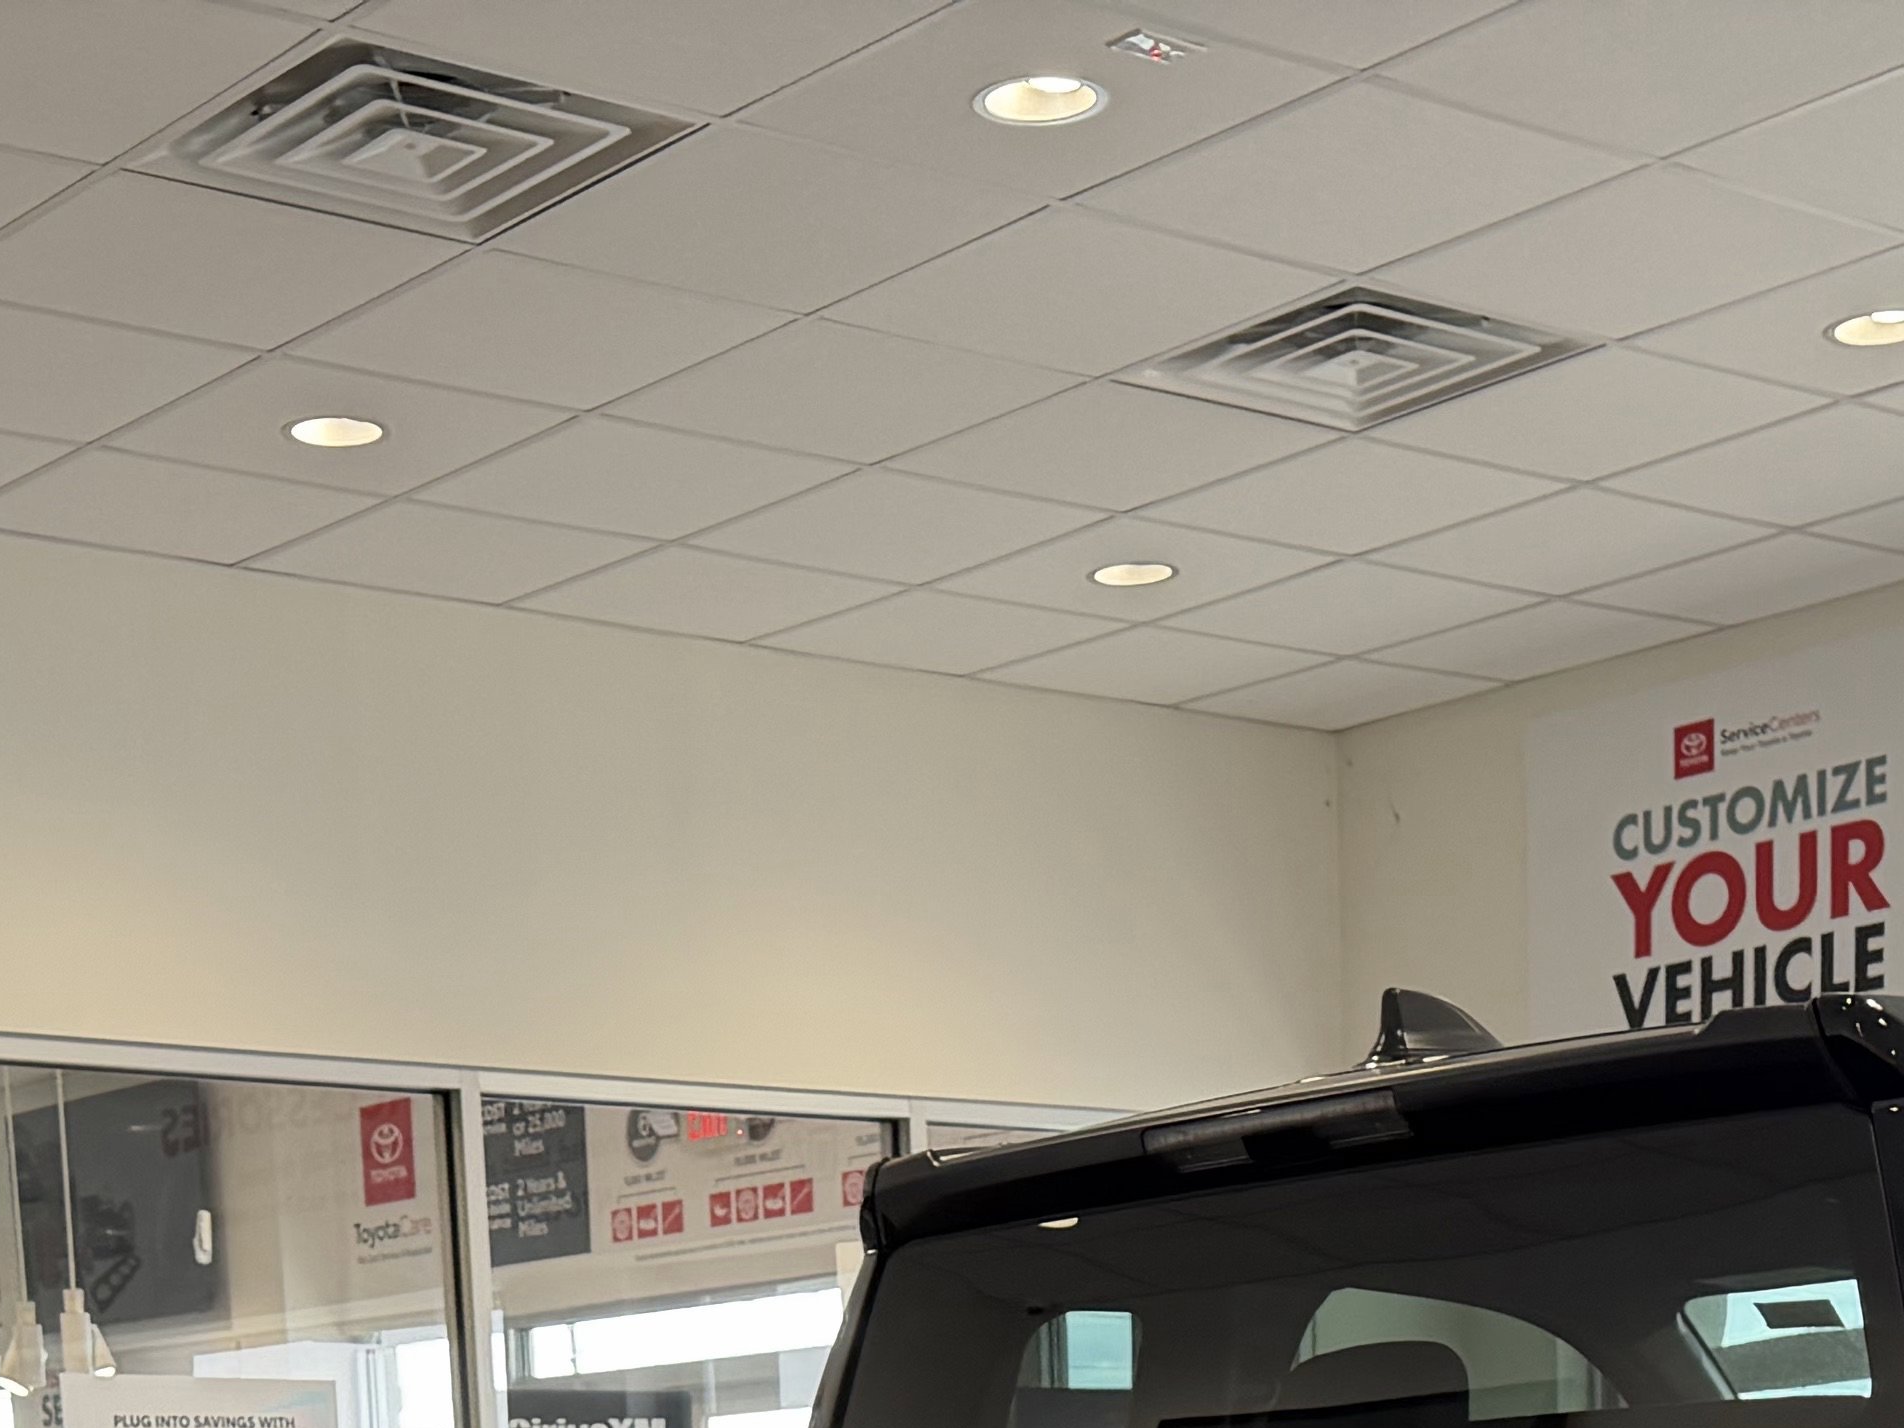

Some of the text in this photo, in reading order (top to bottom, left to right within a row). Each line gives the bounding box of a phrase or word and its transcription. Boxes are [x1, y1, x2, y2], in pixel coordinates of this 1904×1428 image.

[1613, 755, 1887, 861] CUSTOMIZE
[1610, 819, 1891, 959] YOUR
[1613, 921, 1885, 1029] VEHICLE
[353, 1214, 432, 1248] ToyotaCare
[113, 1415, 152, 1428] PLUG
[155, 1415, 191, 1428] INTO
